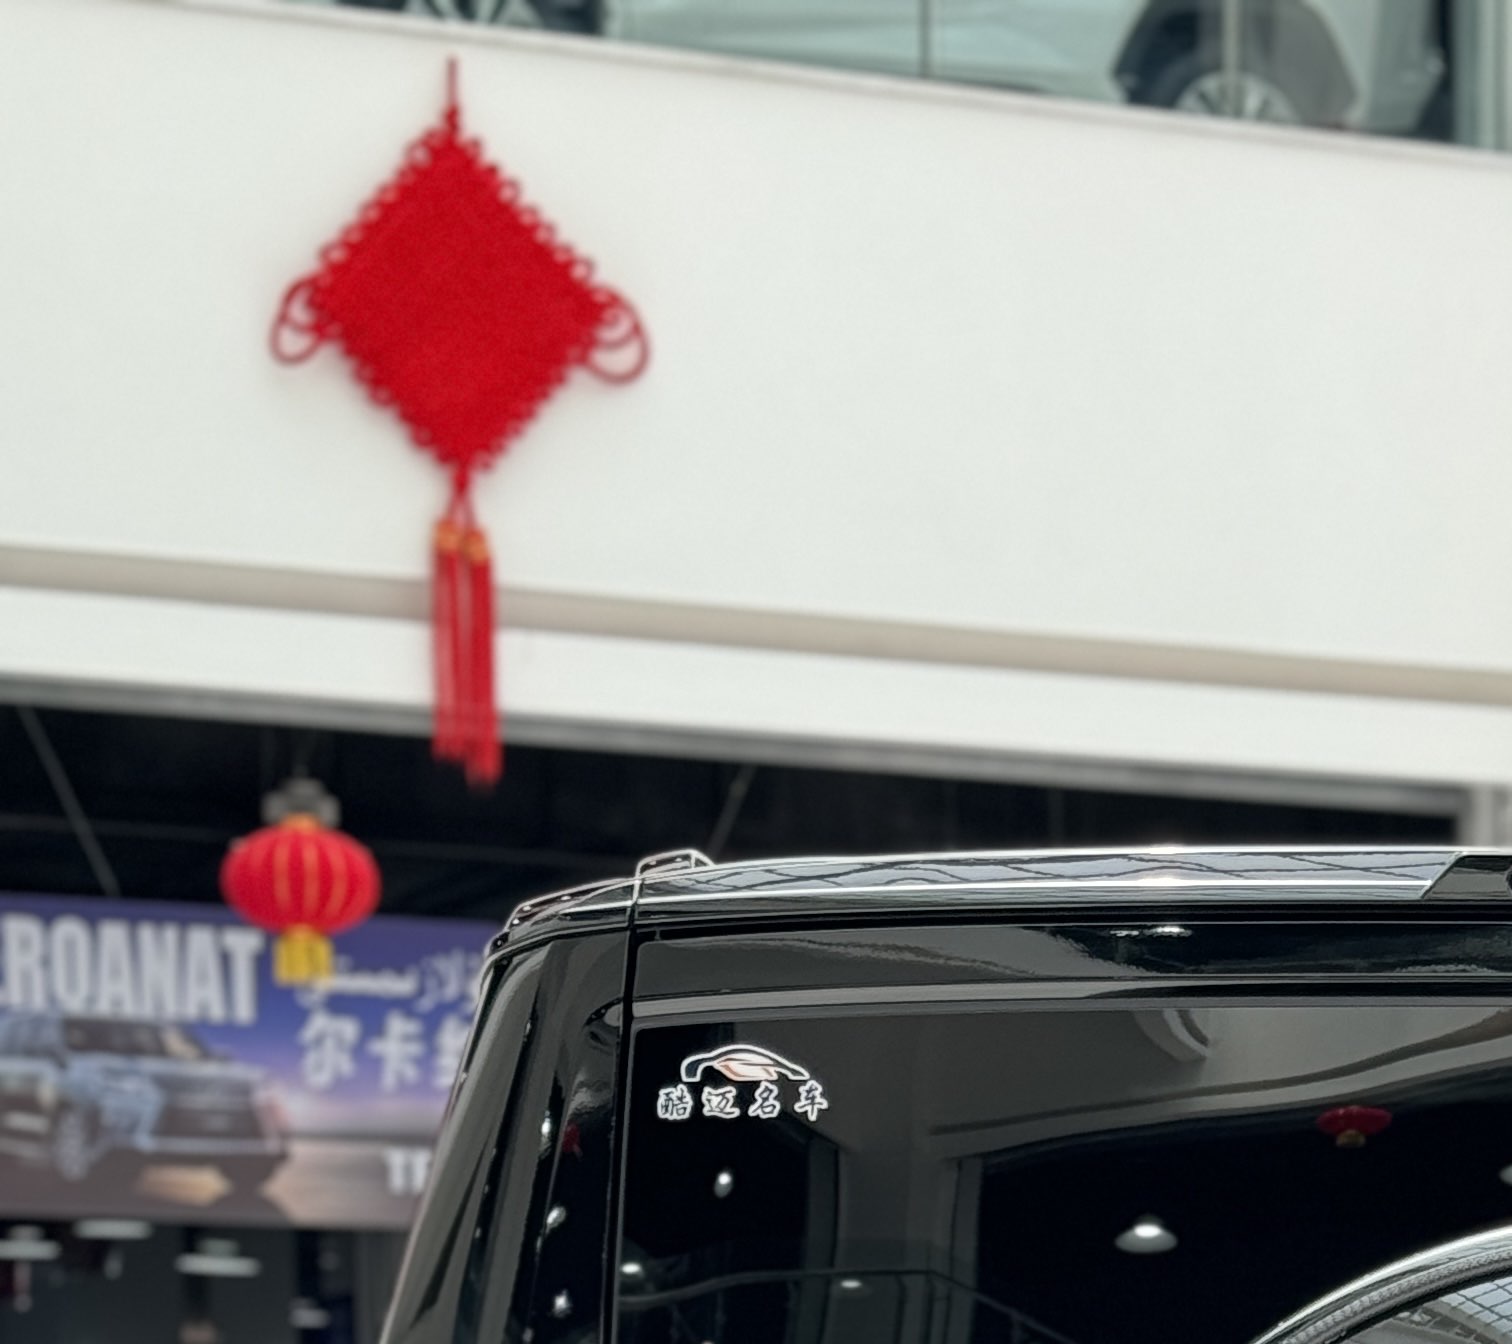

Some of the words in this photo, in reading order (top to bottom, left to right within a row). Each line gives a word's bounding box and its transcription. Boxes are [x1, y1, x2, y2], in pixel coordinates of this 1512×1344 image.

[0, 911, 266, 1028] ROANAT
[656, 1079, 830, 1123] 酷迈名车
